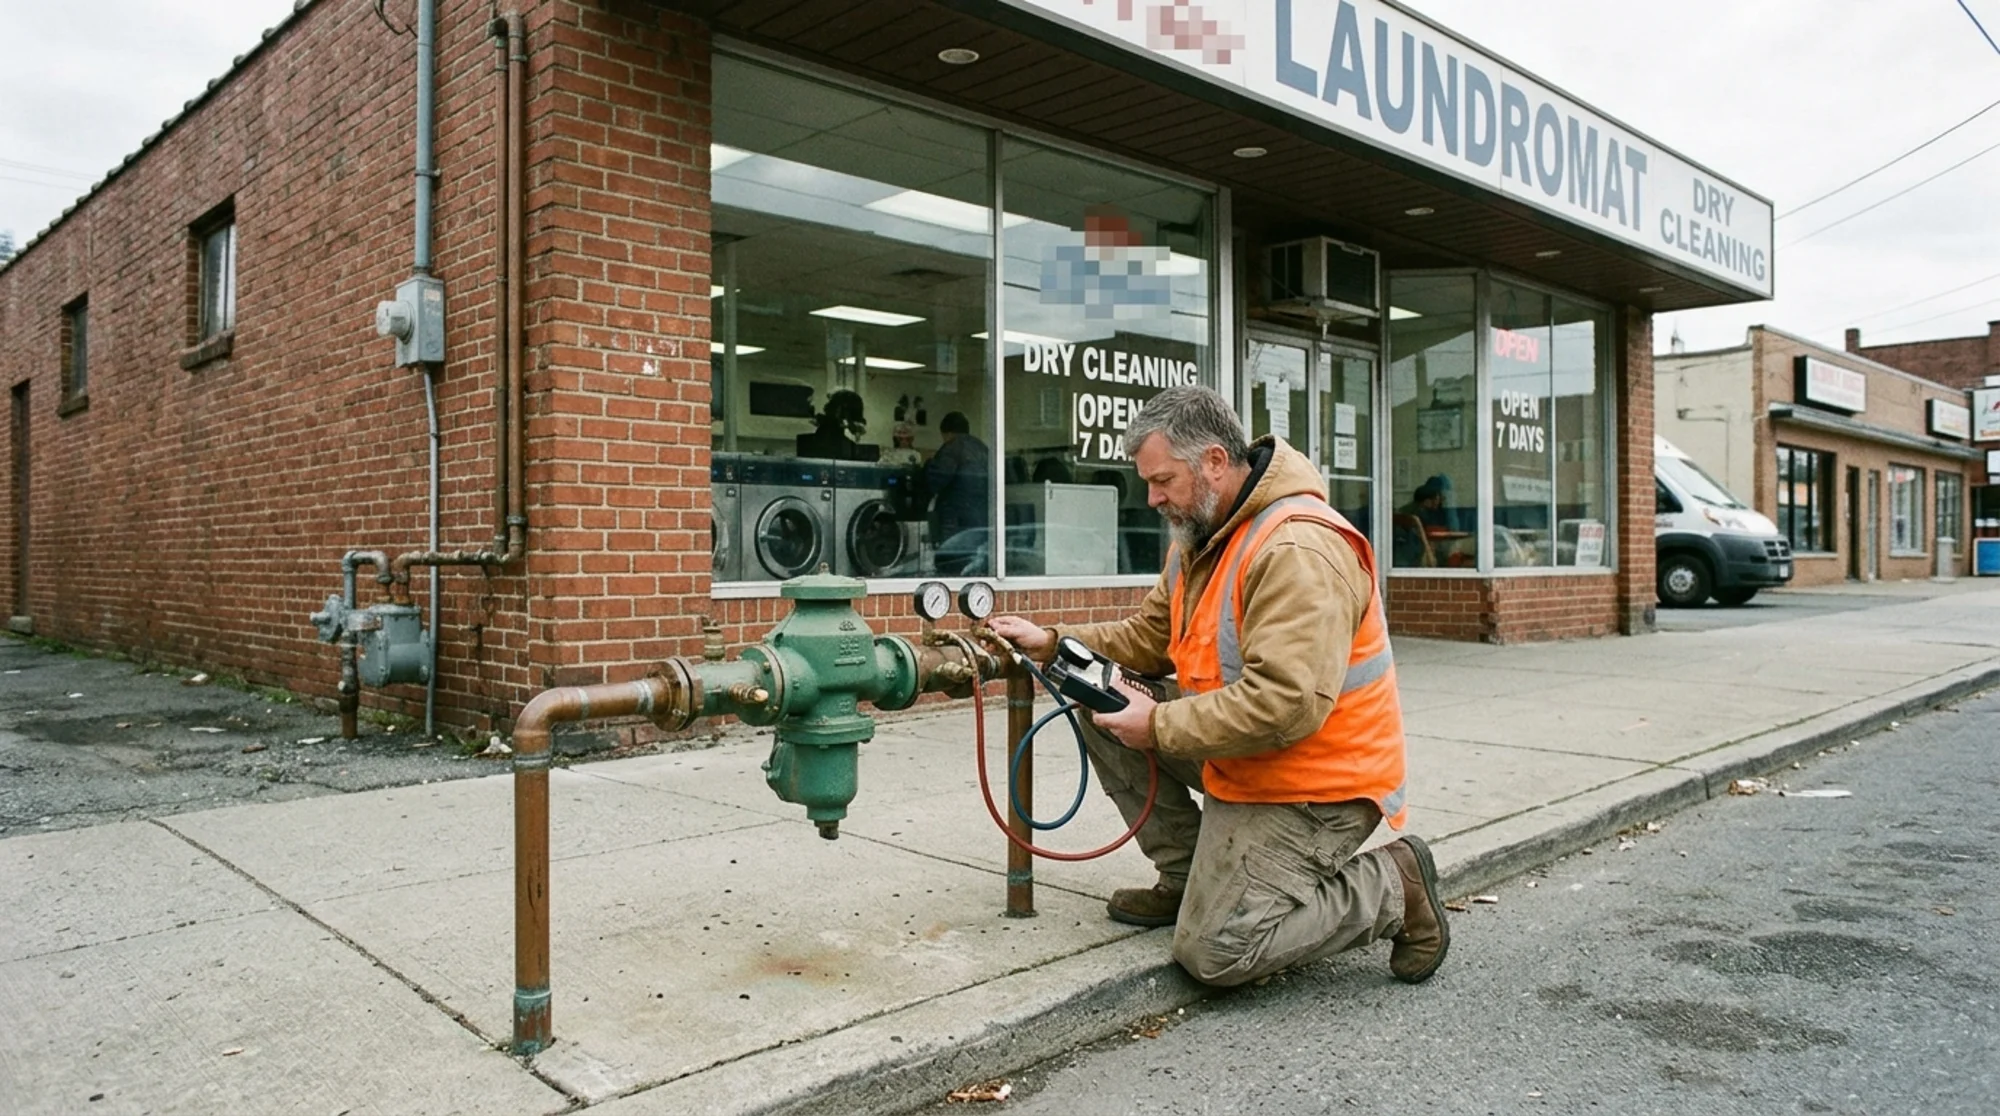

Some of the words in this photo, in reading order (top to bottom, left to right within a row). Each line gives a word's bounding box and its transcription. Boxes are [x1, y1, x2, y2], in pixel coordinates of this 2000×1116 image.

[1276, 0, 1647, 231] LAUNDROMAT
[1693, 178, 1734, 227] DRY
[1660, 208, 1765, 281] CLEANING
[1024, 340, 1076, 377] DRY
[1082, 346, 1198, 389] CLEANING
[1496, 328, 1539, 363] OPEN
[1501, 389, 1540, 420] OPEN
[1079, 431, 1093, 459] 7
[1099, 433, 1135, 462] DA
[1496, 421, 1505, 449] 7
[1509, 425, 1544, 453] DAYS
